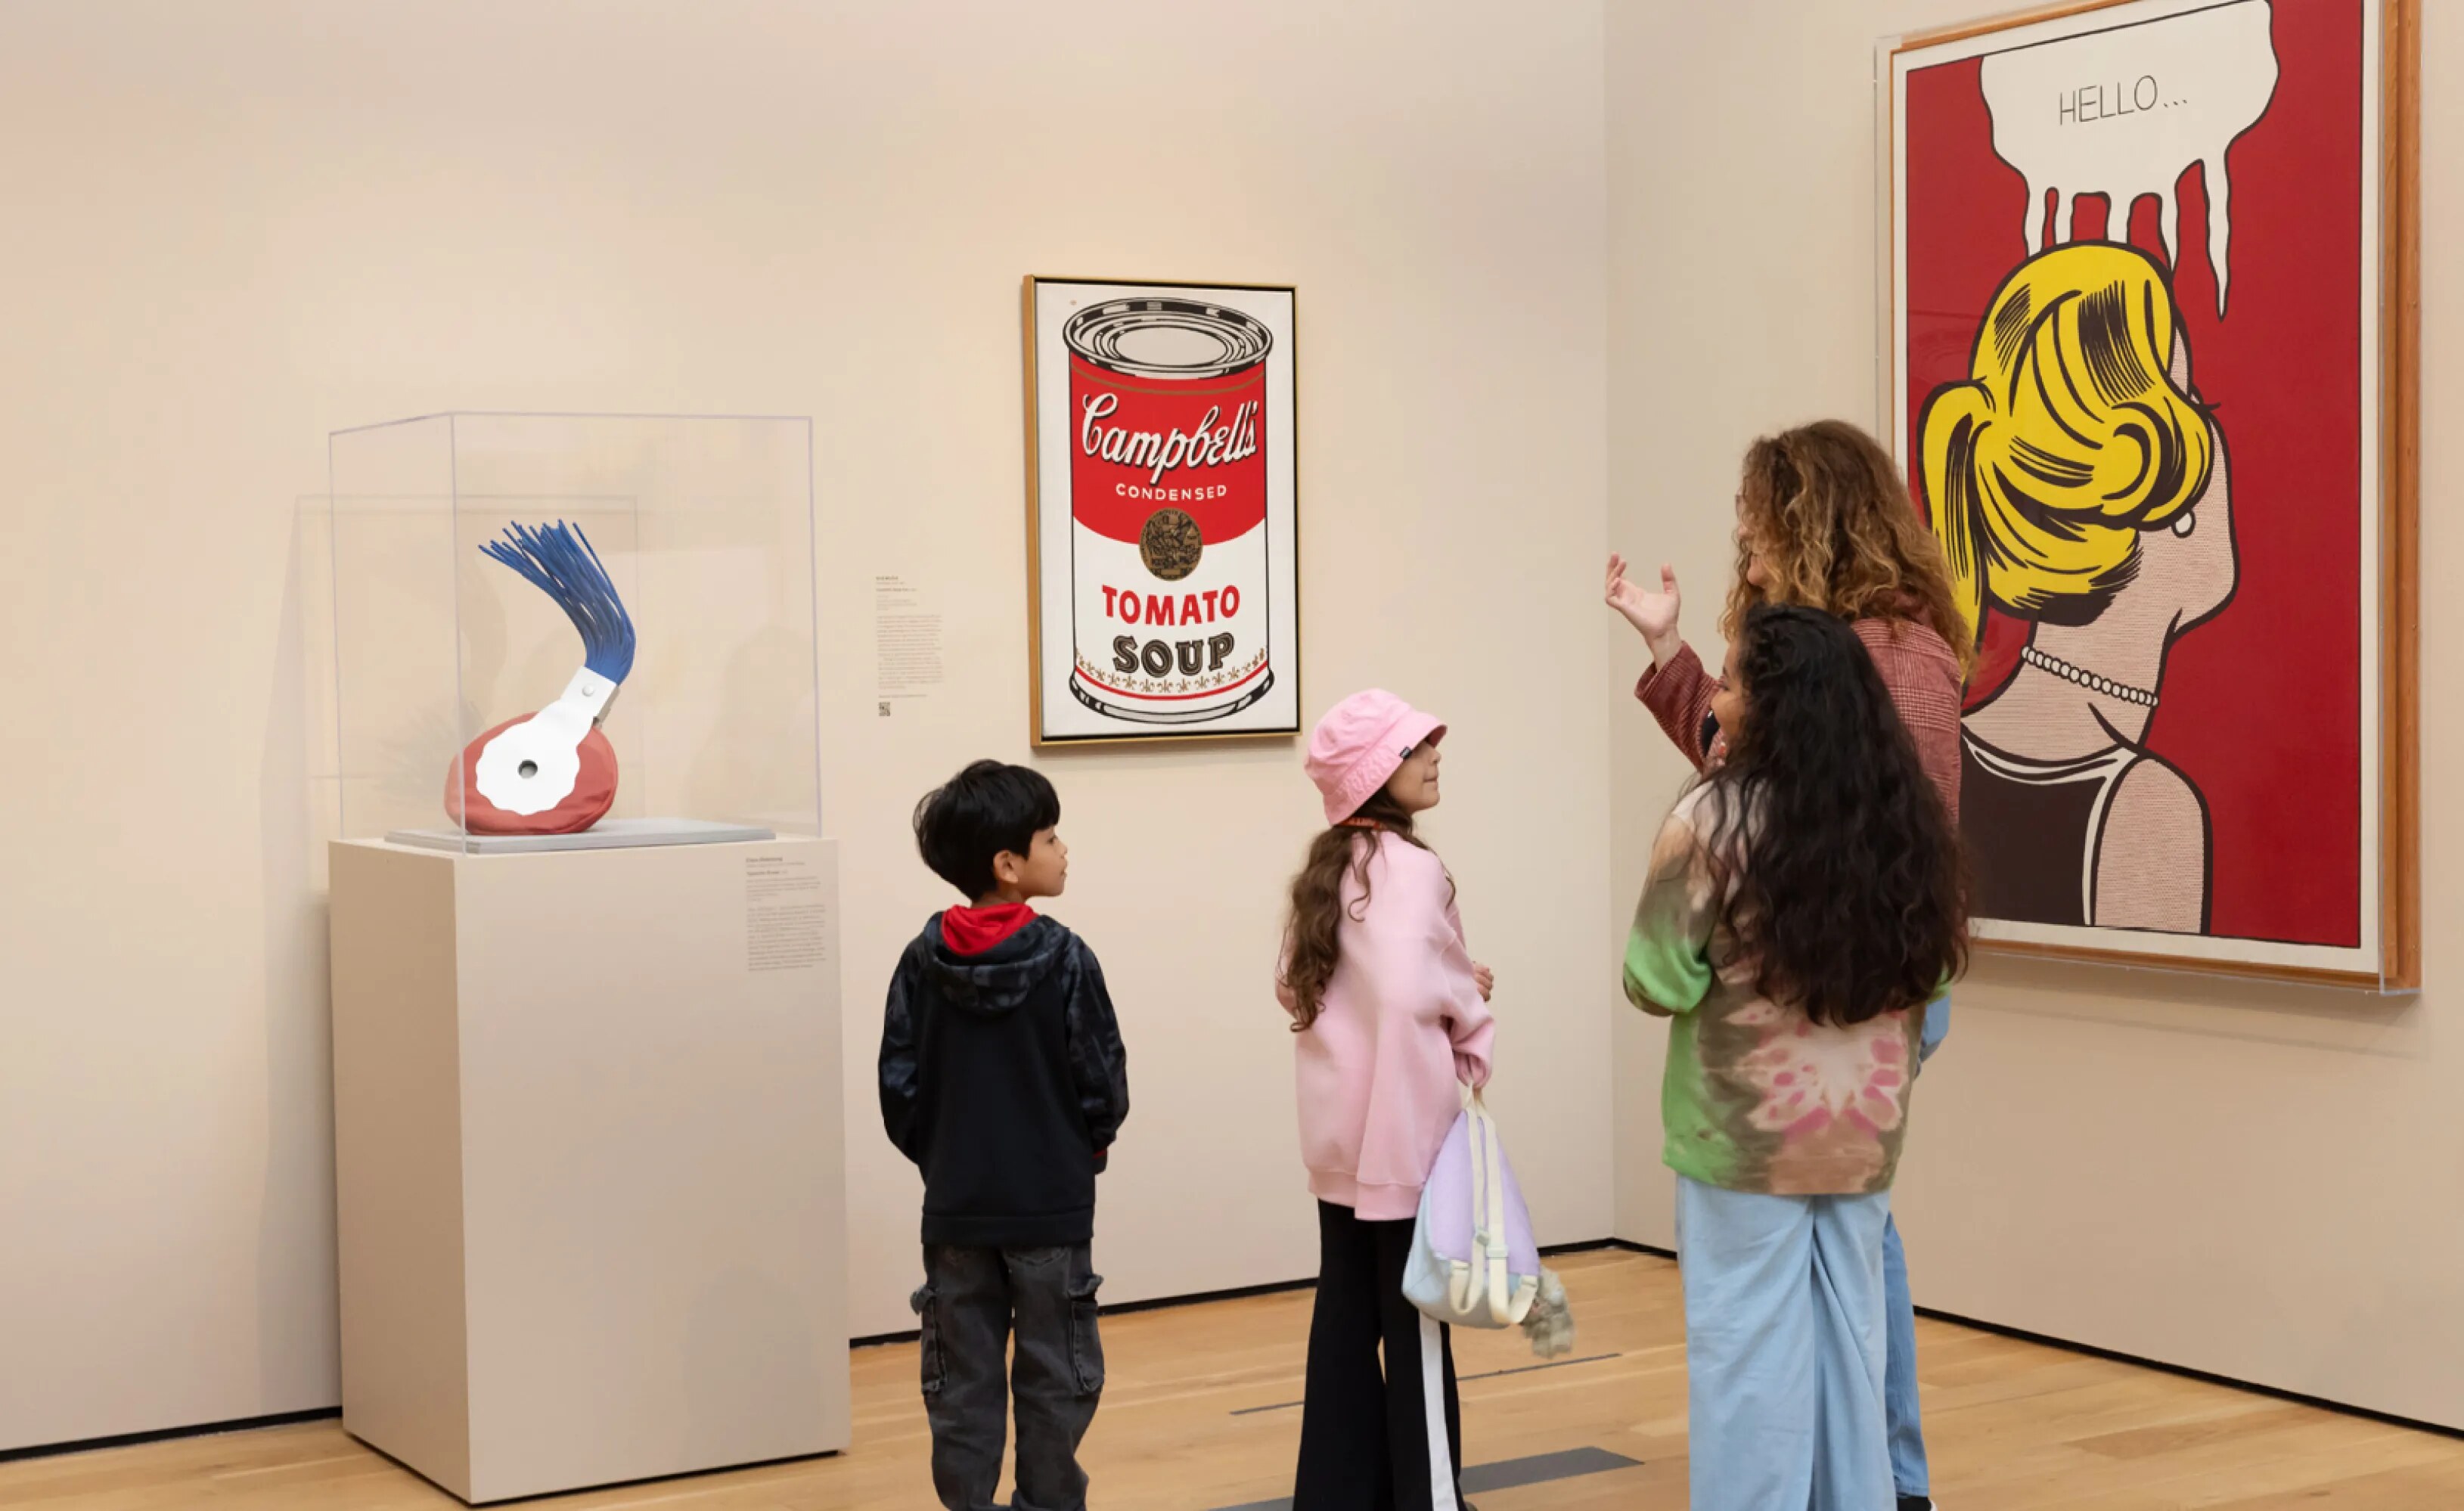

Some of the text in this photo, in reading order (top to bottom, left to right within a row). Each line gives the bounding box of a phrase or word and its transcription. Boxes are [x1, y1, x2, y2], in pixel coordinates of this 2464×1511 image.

[2059, 75, 2187, 126] HELLO...
[1082, 392, 1259, 486] Campbell's
[1116, 482, 1227, 501] CONDENSED
[1102, 584, 1240, 626] TOMATO
[1113, 631, 1235, 678] SOUP
